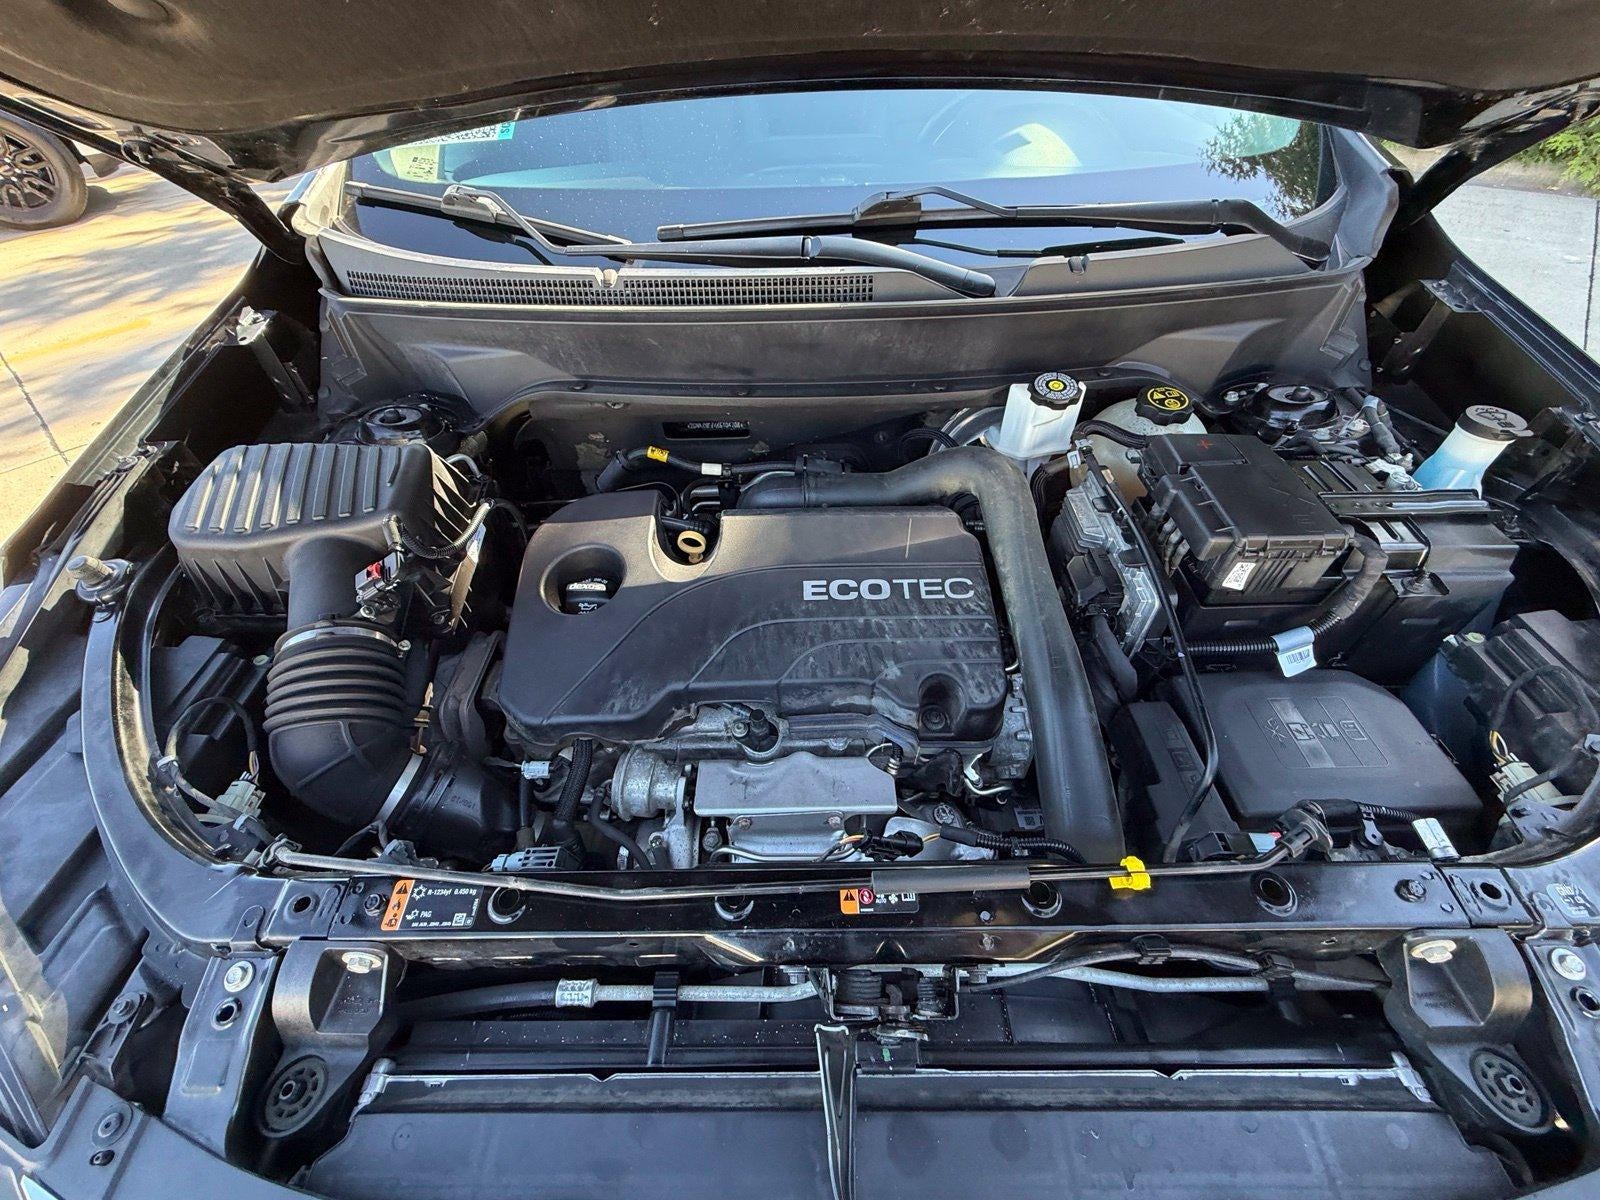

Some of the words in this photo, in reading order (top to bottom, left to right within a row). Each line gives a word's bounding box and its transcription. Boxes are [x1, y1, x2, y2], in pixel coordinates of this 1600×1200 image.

[802, 577, 975, 601] ECOTEC
[427, 888, 452, 896] R-1234yf
[469, 888, 478, 896] kg
[420, 910, 433, 918] PAG
